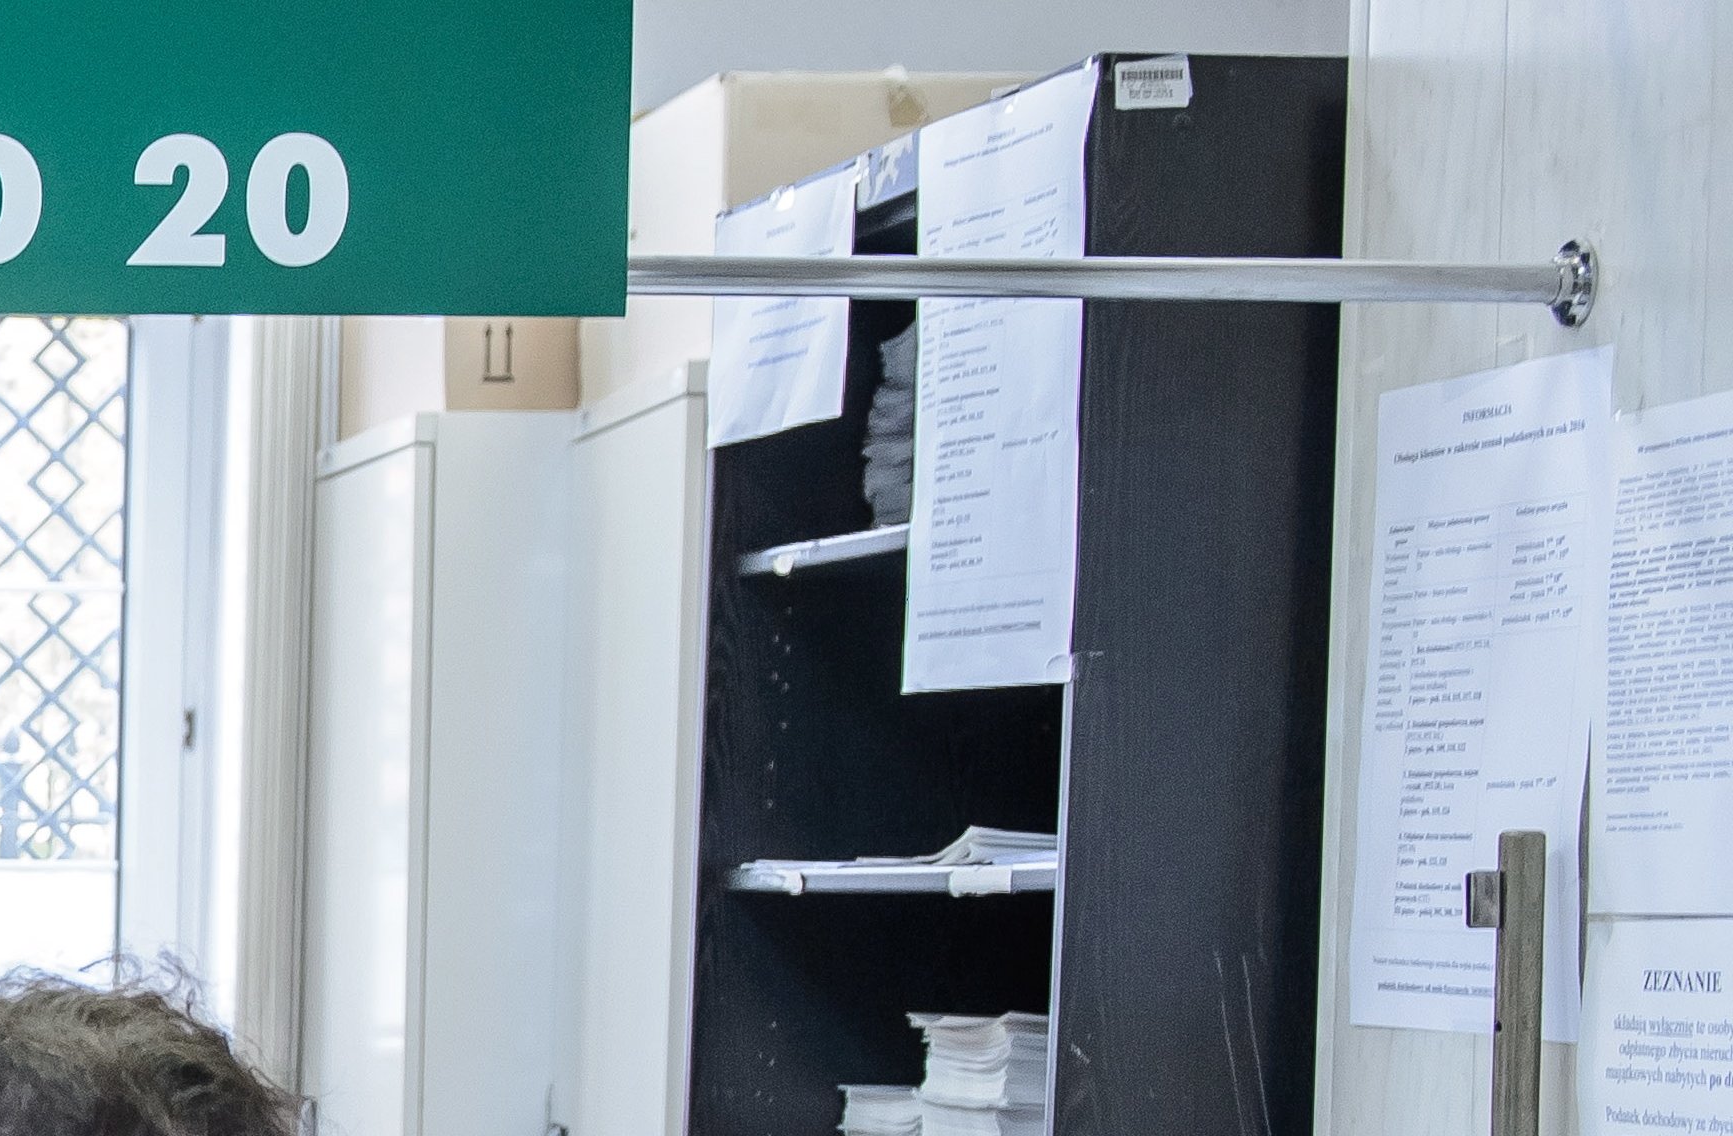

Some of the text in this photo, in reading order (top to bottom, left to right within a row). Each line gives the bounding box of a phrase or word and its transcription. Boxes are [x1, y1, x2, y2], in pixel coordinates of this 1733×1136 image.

[125, 132, 349, 267] 20
[1642, 969, 1723, 993] ZEZNANIE
[1709, 1073, 1722, 1091] po
